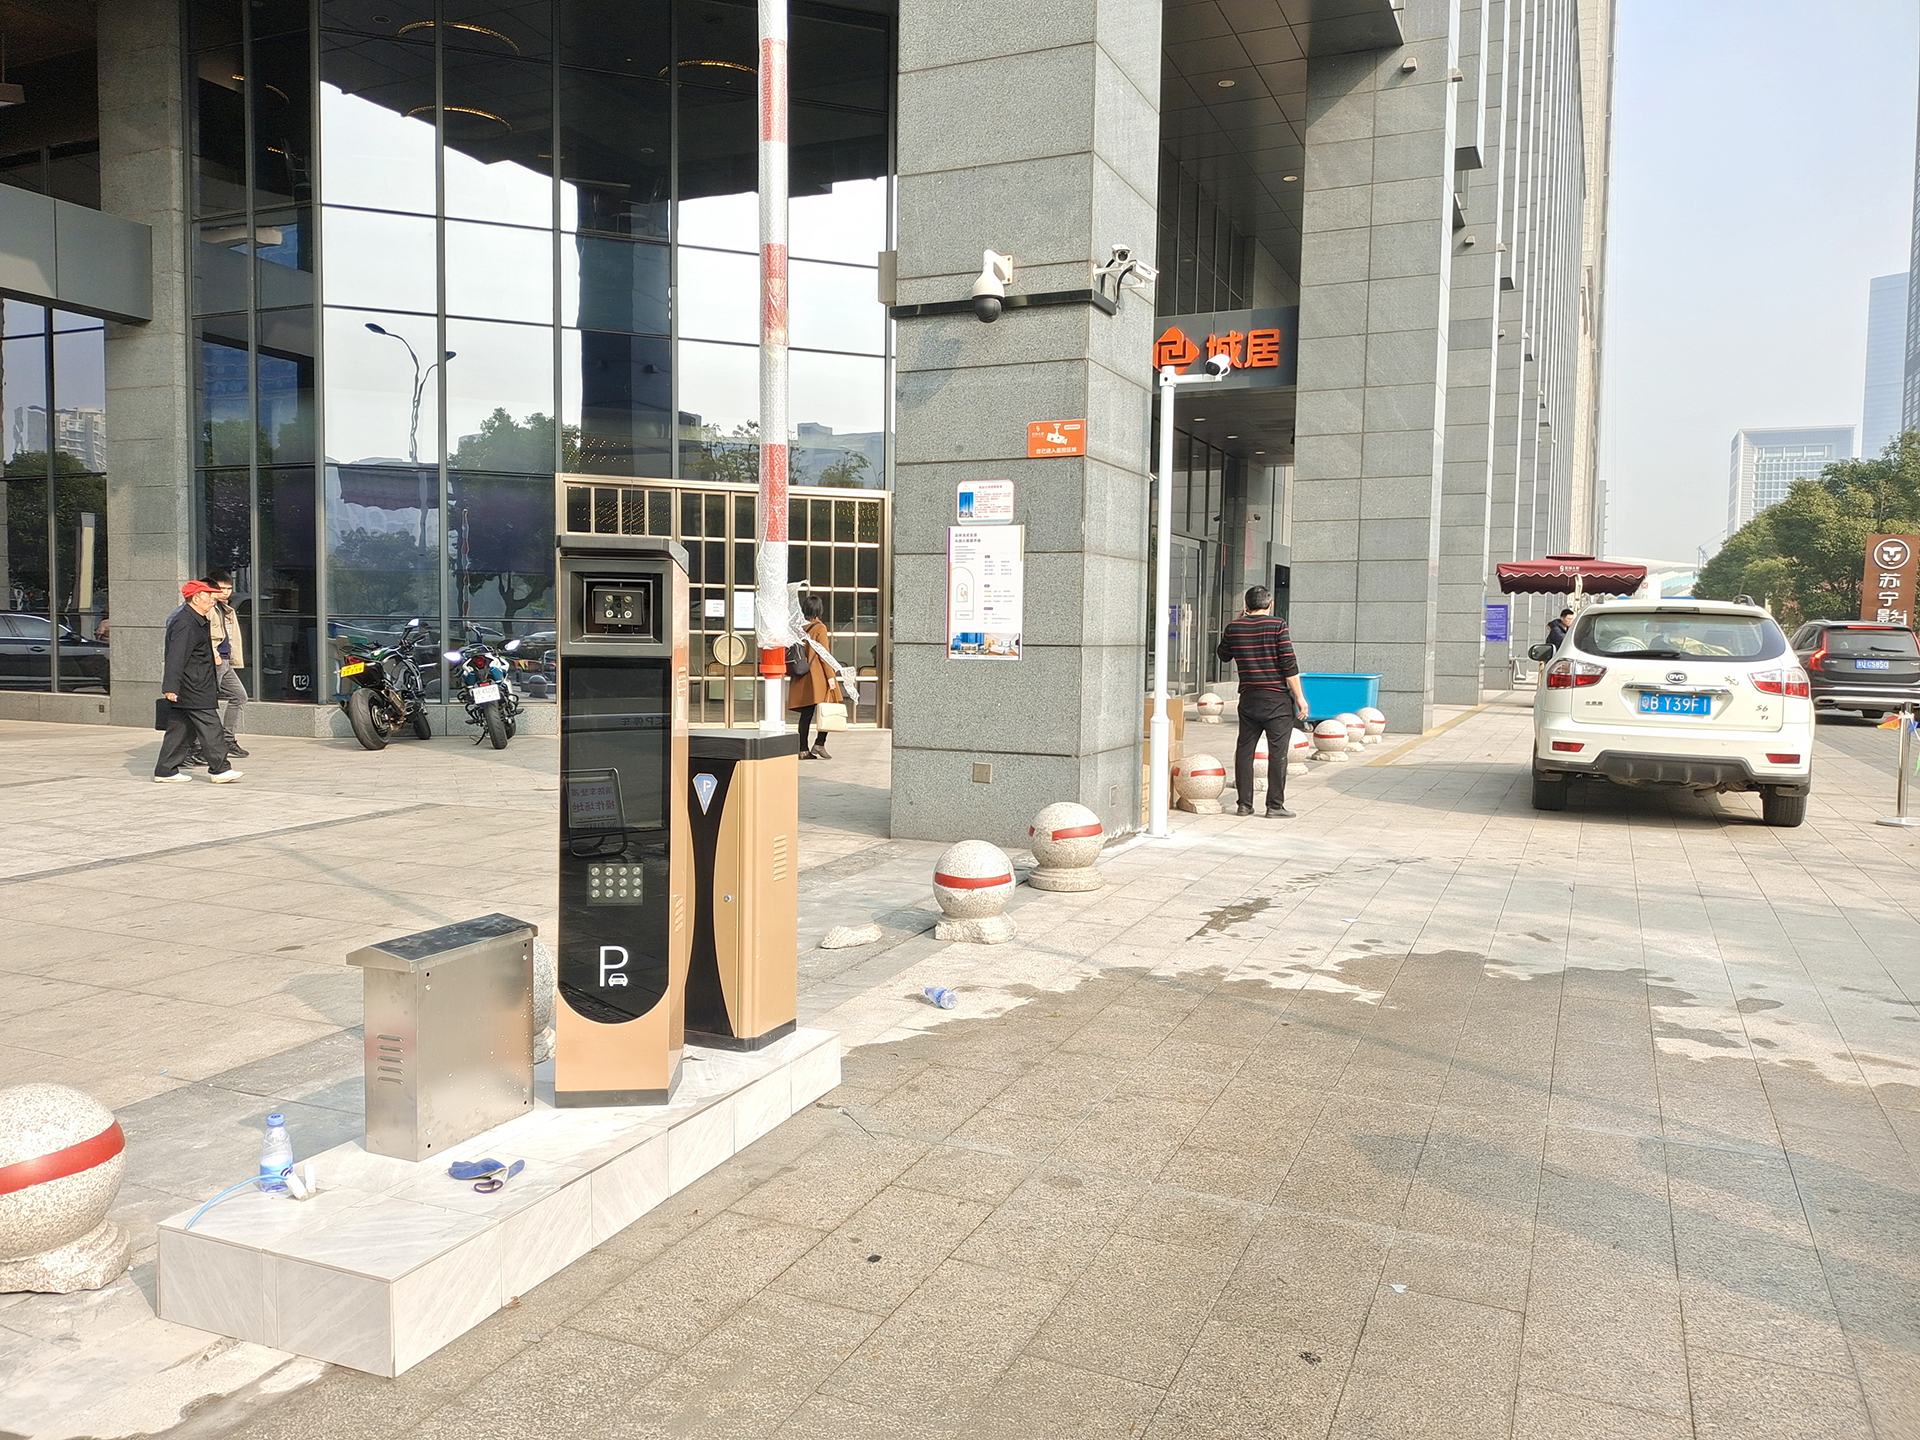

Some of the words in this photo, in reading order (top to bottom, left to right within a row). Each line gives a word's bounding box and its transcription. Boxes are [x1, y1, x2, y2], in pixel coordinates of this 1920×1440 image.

[1205, 328, 1281, 369] 城居
[1877, 572, 1902, 623] 苏宁影
[1755, 704, 1768, 712] S6
[703, 779, 712, 793] P
[599, 945, 629, 987] P
